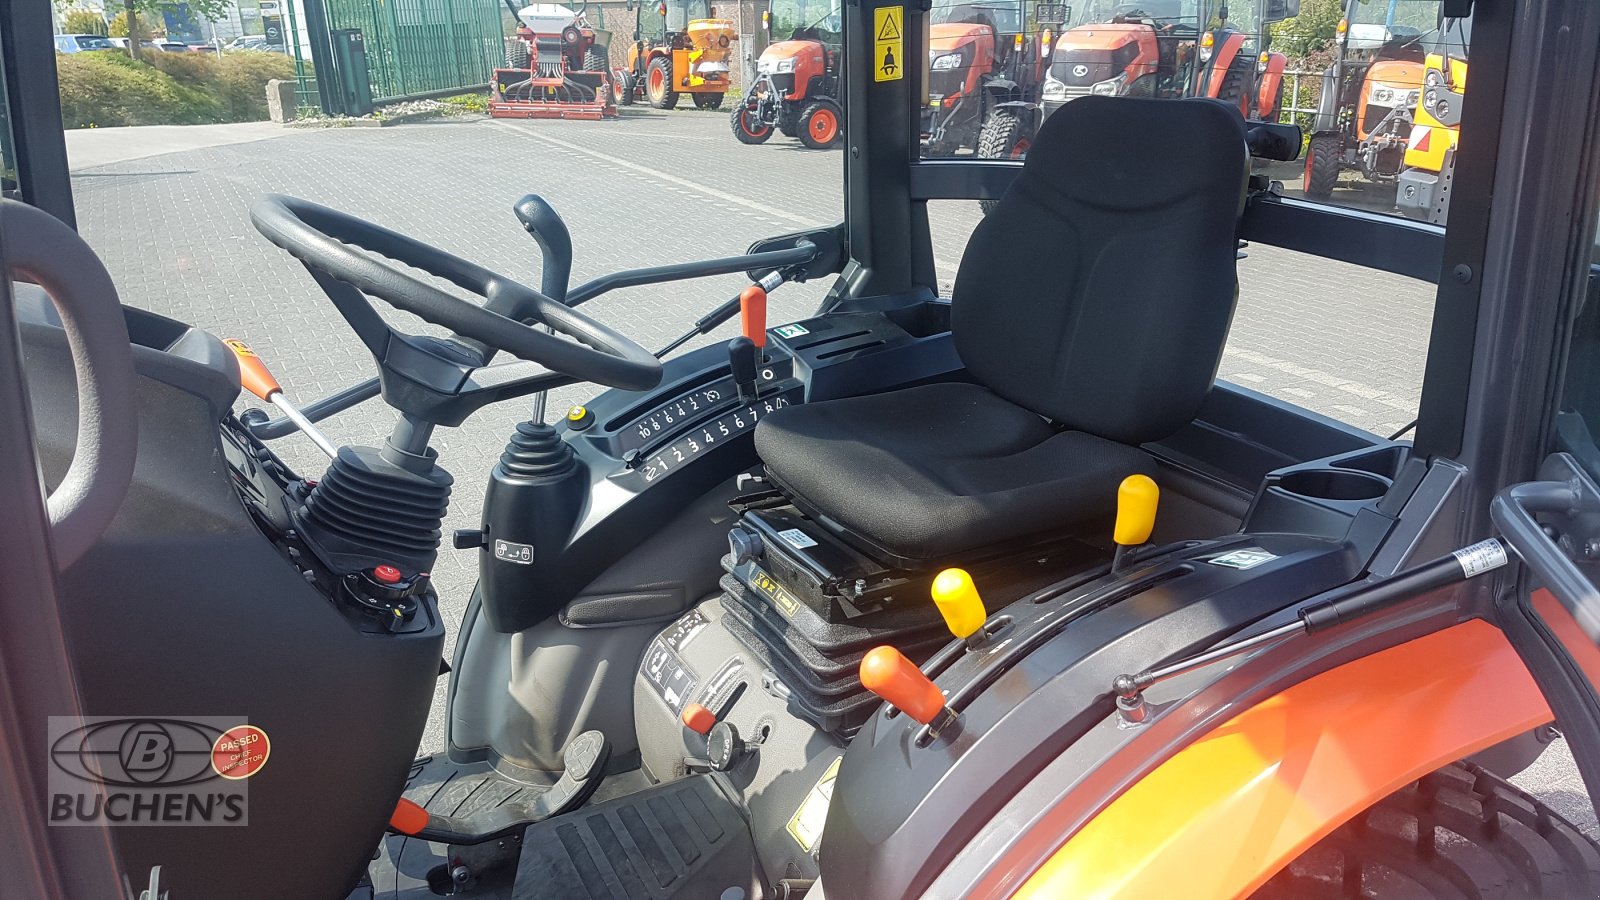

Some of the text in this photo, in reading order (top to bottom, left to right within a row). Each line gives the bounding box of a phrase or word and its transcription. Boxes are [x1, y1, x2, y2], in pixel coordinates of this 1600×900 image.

[638, 401, 700, 439] 10 8 6 4 2
[659, 460, 669, 471] 1
[673, 450, 685, 462] 2
[688, 441, 700, 453] 3
[705, 432, 714, 443] 4
[719, 424, 730, 436] 5
[735, 417, 745, 428] 6
[749, 410, 758, 422] 7
[220, 733, 259, 752] PASSED
[722, 738, 730, 760] OPEN
[222, 754, 263, 772] INSPECTOR
[230, 749, 252, 761] CHIEF
